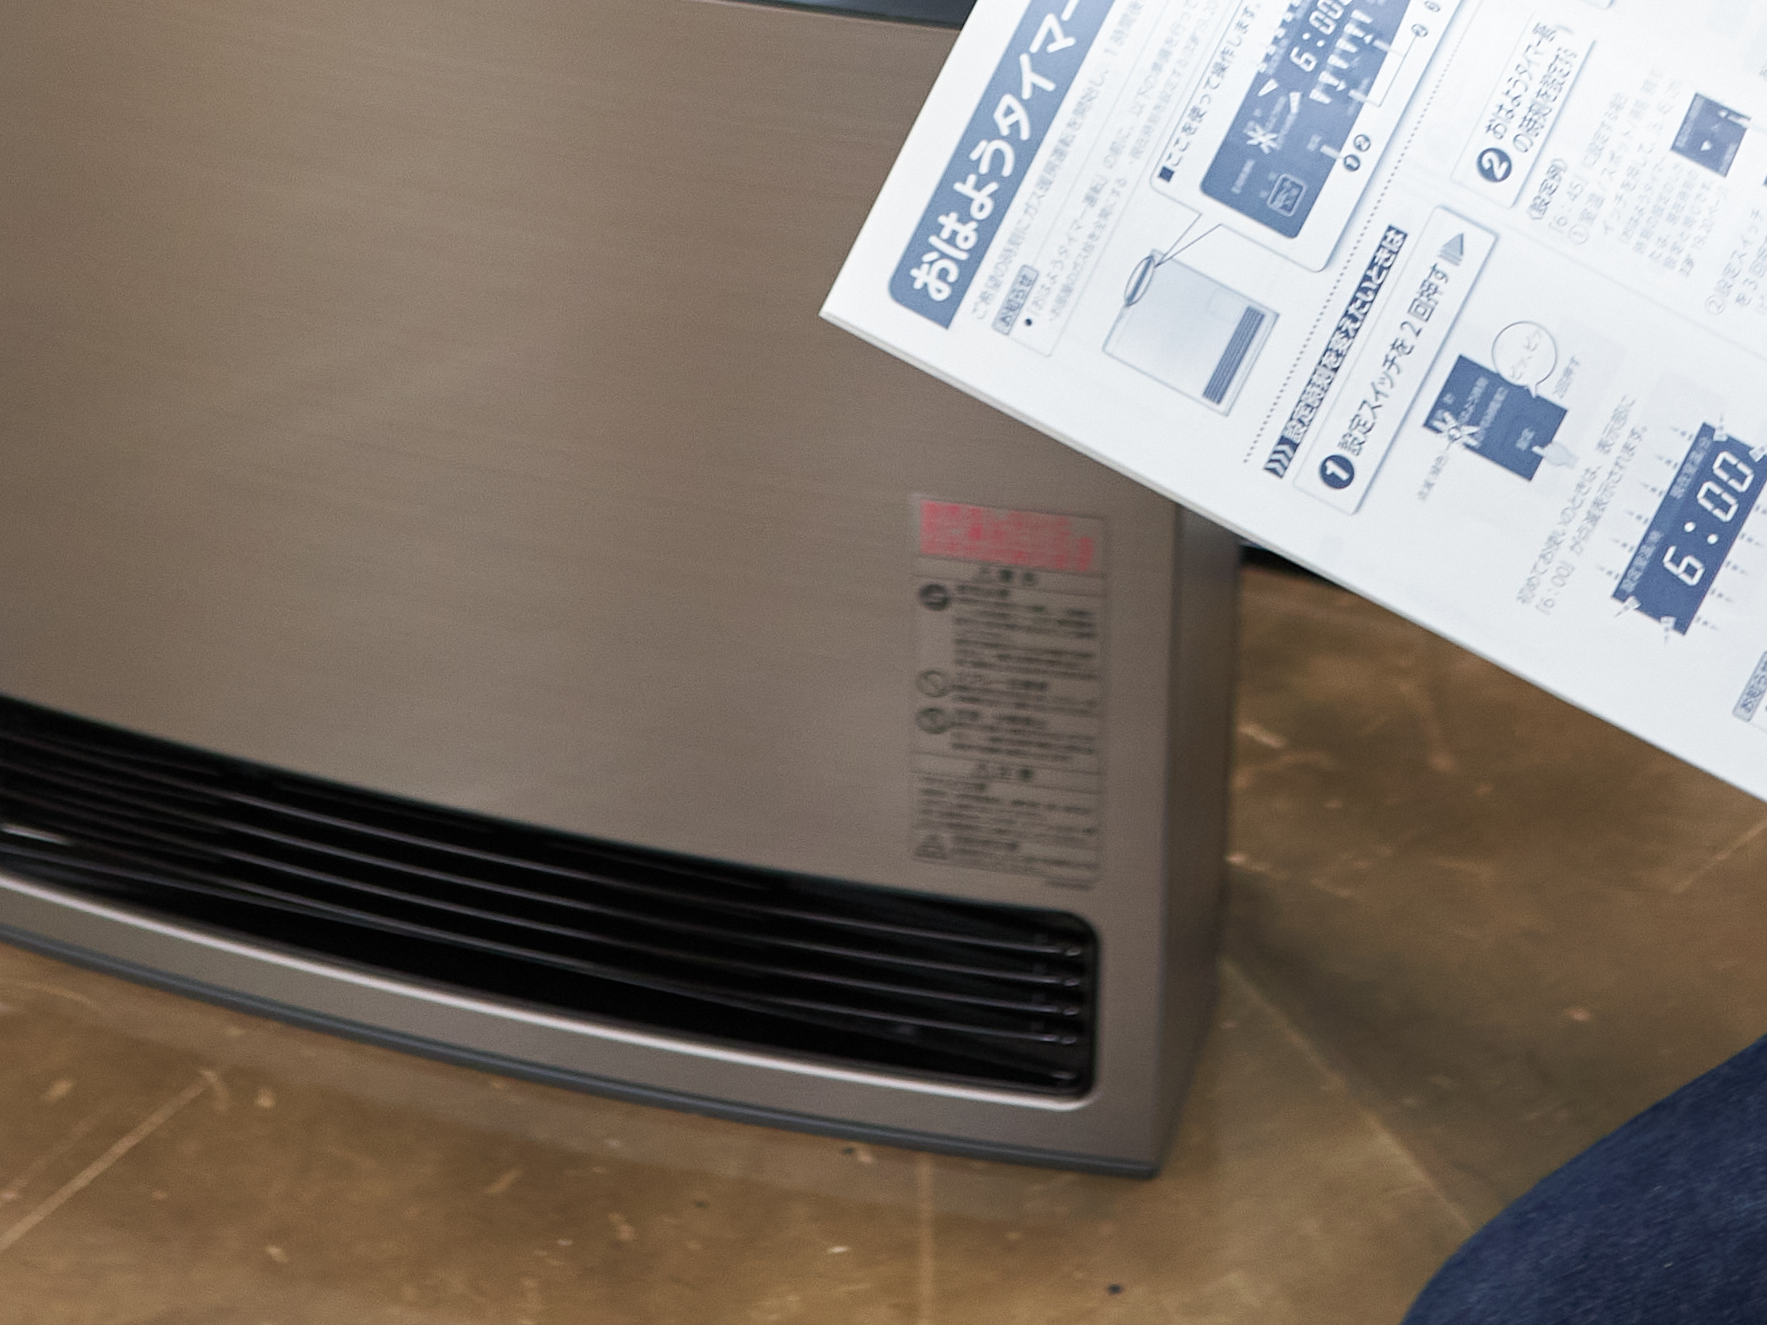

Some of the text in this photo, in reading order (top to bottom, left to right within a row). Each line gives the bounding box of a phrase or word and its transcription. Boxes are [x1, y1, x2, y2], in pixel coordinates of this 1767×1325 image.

[1282, 225, 1406, 443] 設定時刻を変えたいときは
[1658, 448, 1758, 588] 6:00
